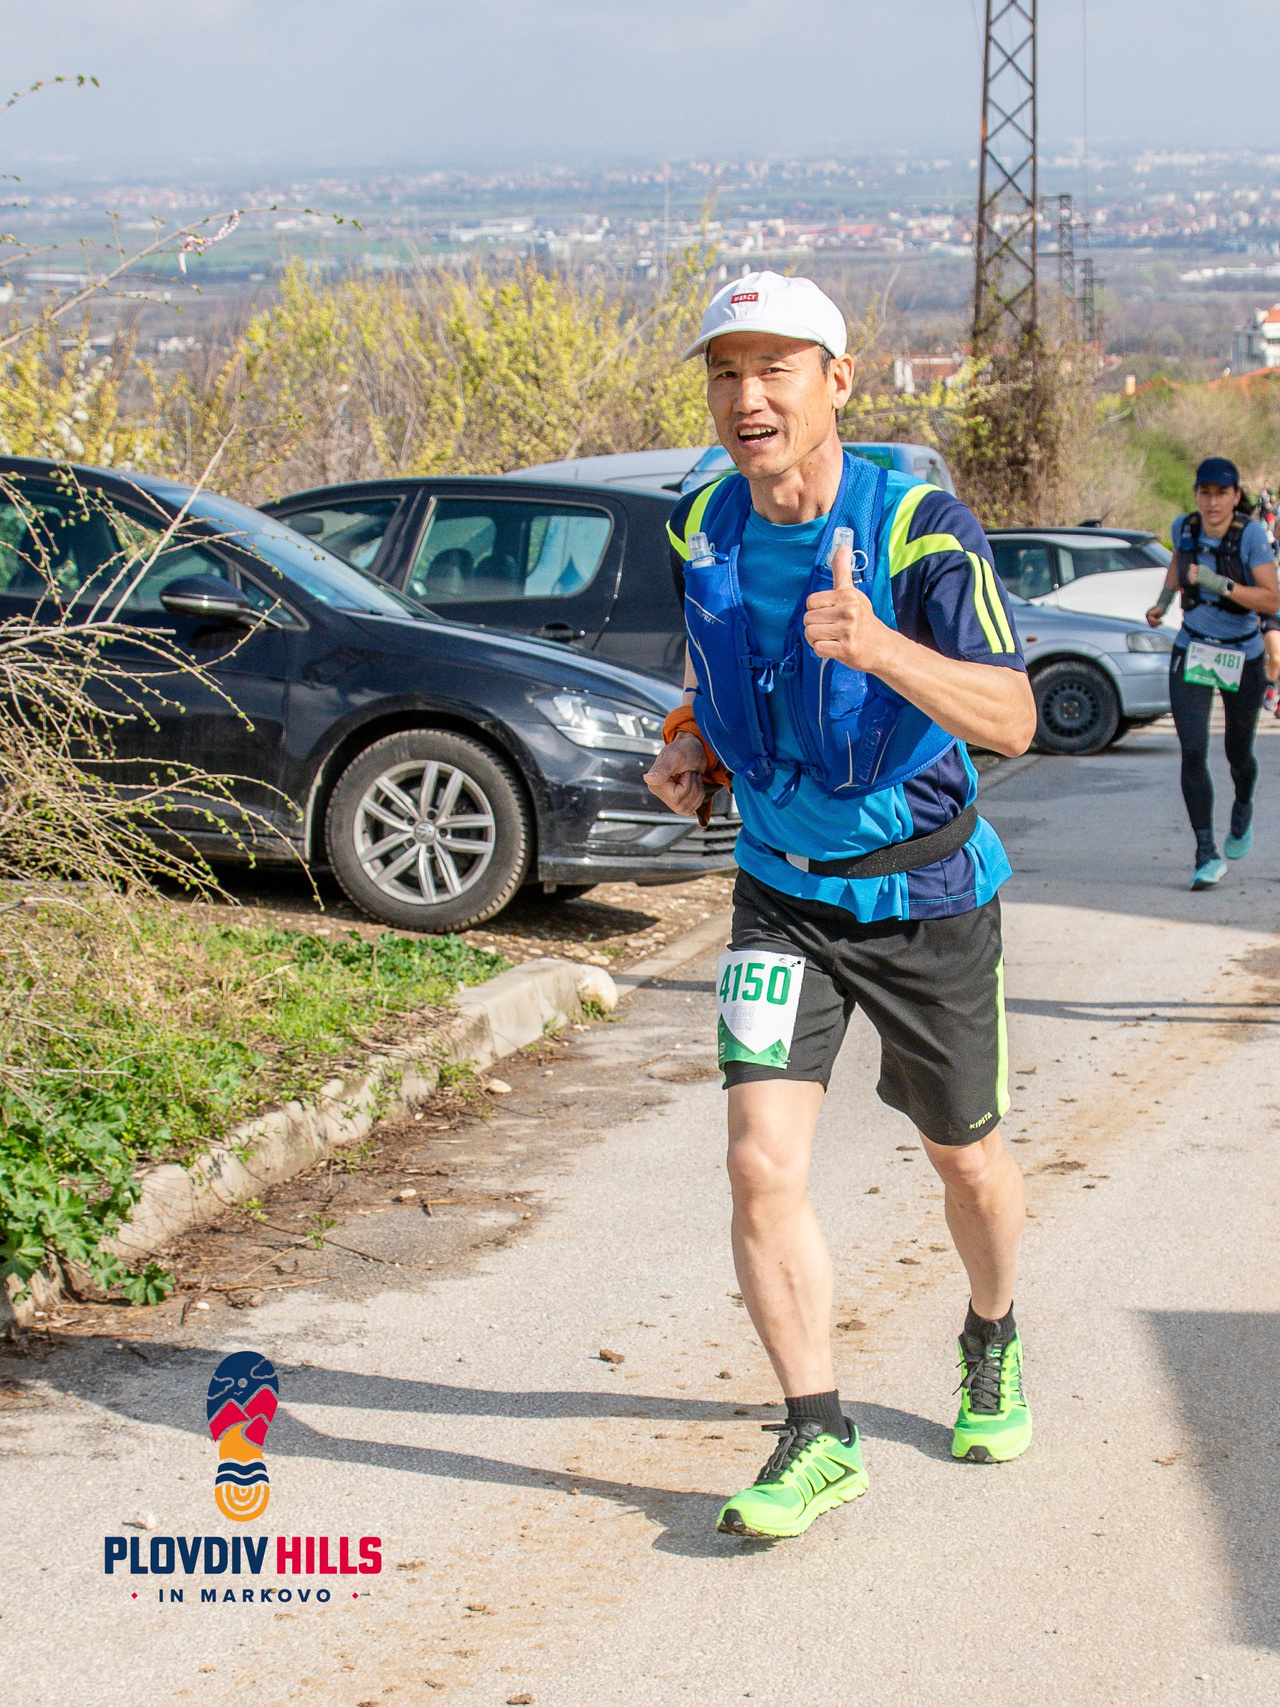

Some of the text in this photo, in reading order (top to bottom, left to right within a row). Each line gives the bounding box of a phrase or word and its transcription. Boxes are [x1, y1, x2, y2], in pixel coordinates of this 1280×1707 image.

[1214, 652, 1241, 669] 4181
[719, 962, 792, 1005] 4150
[970, 1111, 993, 1129] KIPSTA
